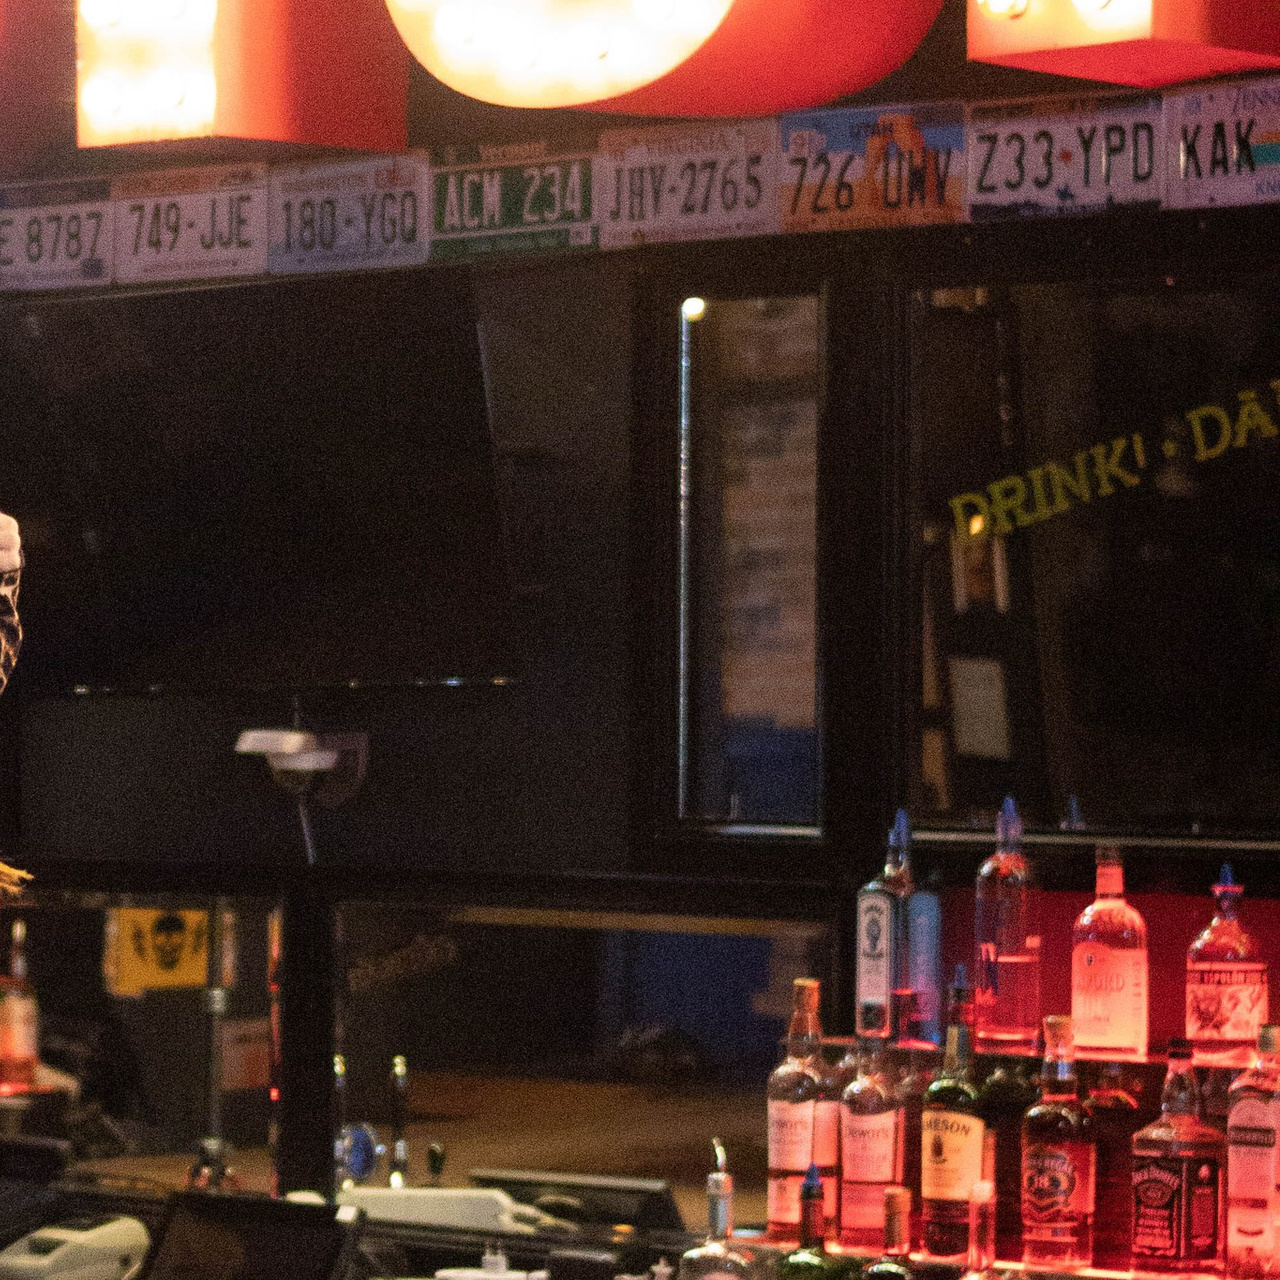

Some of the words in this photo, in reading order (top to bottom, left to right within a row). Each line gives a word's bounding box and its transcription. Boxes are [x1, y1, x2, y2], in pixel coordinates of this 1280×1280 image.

[976, 129, 1054, 193] Z33
[1076, 121, 1155, 188] YPD
[1179, 117, 1257, 181] KAK
[444, 171, 502, 229] ACM
[522, 162, 582, 223] 234
[788, 152, 855, 216] 726
[25, 211, 104, 263] 8787
